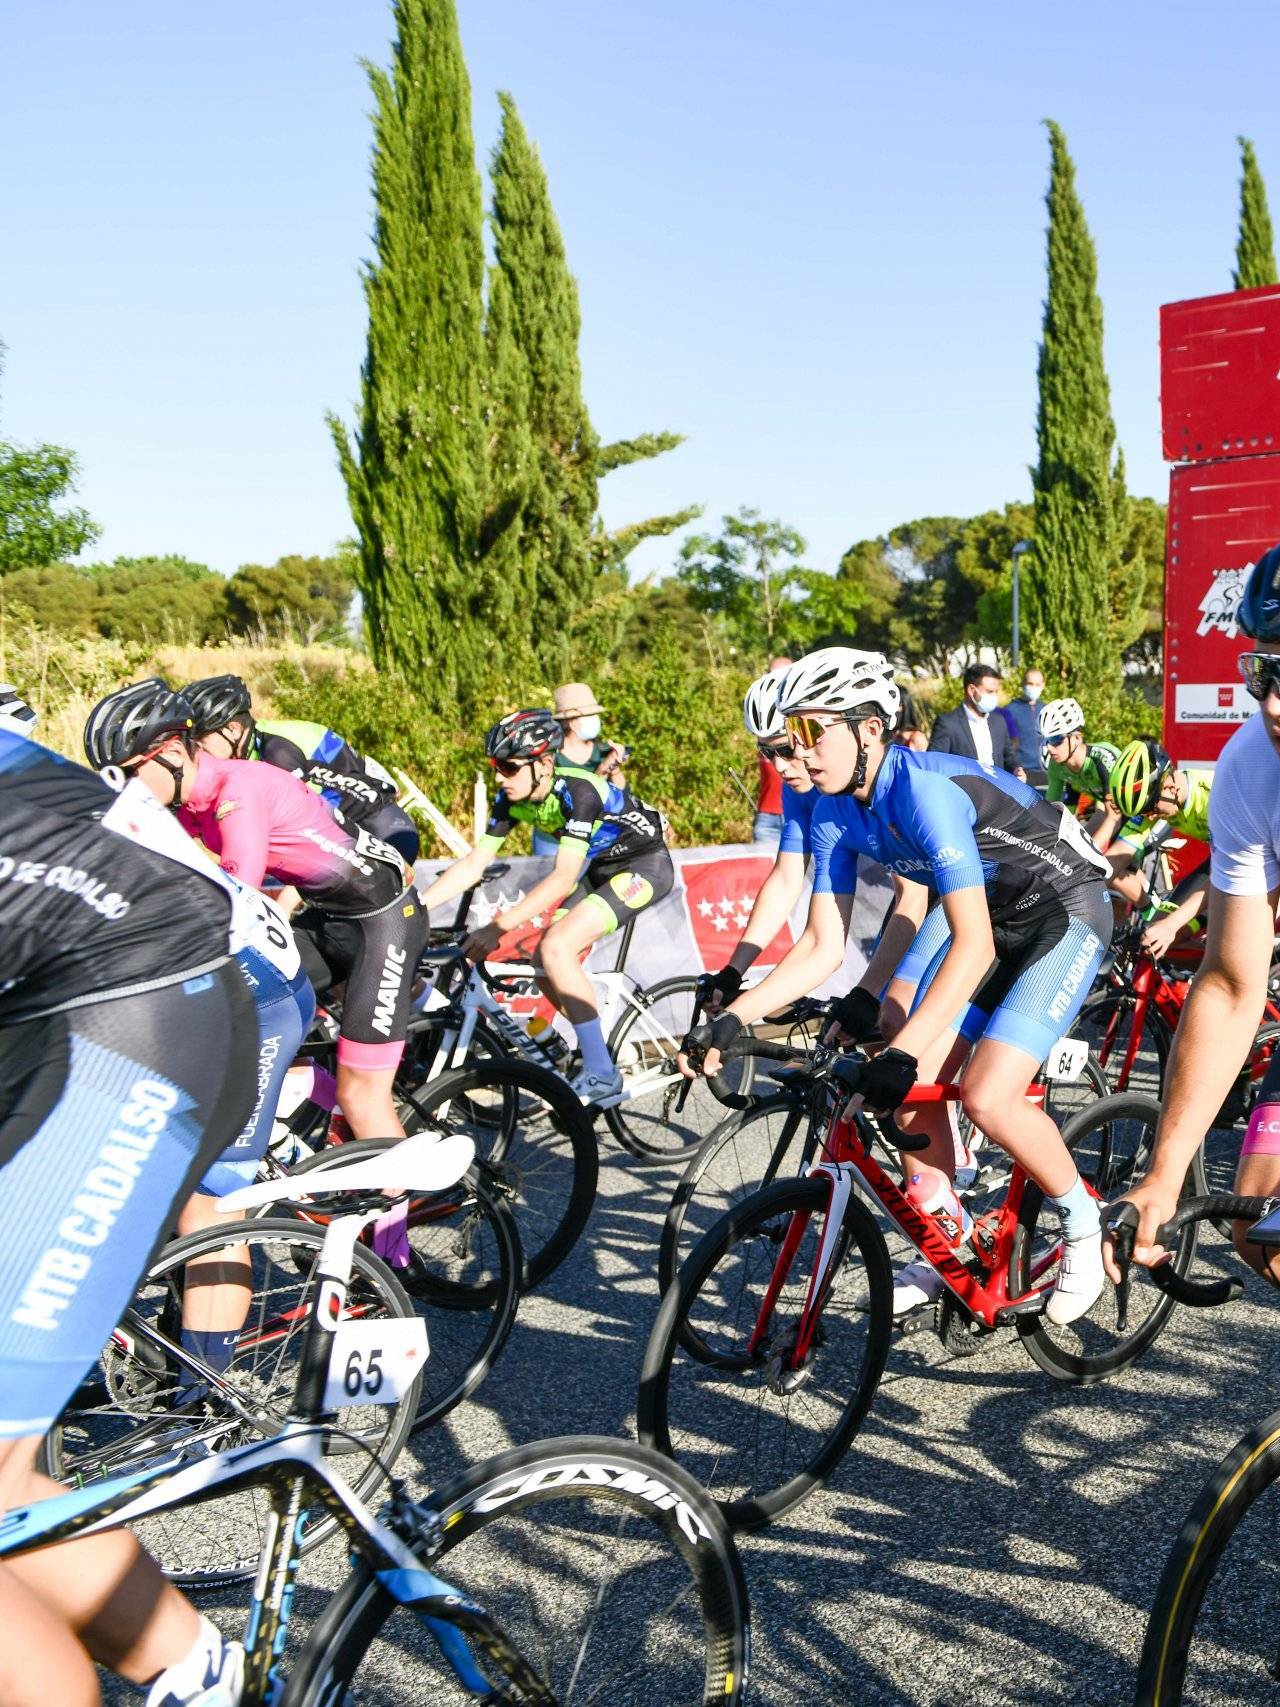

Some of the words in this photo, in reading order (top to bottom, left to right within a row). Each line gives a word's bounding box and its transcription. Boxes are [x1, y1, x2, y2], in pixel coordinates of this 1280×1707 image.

[1204, 611, 1234, 624] FM
[1180, 711, 1227, 720] Comunidad
[1229, 711, 1239, 720] de
[309, 766, 379, 804] KUOTA
[1039, 849, 1074, 877] CADALSO
[45, 864, 131, 920] CADALSO
[371, 943, 407, 1038] MAVIC
[1047, 990, 1070, 1024] MTB
[1061, 931, 1101, 996] CADALSO
[1057, 1051, 1074, 1076] 64
[11, 1246, 92, 1332] MTB
[59, 1079, 180, 1248] CADALSO
[875, 1180, 969, 1280] SPECIALIZED
[343, 1348, 384, 1398] 65
